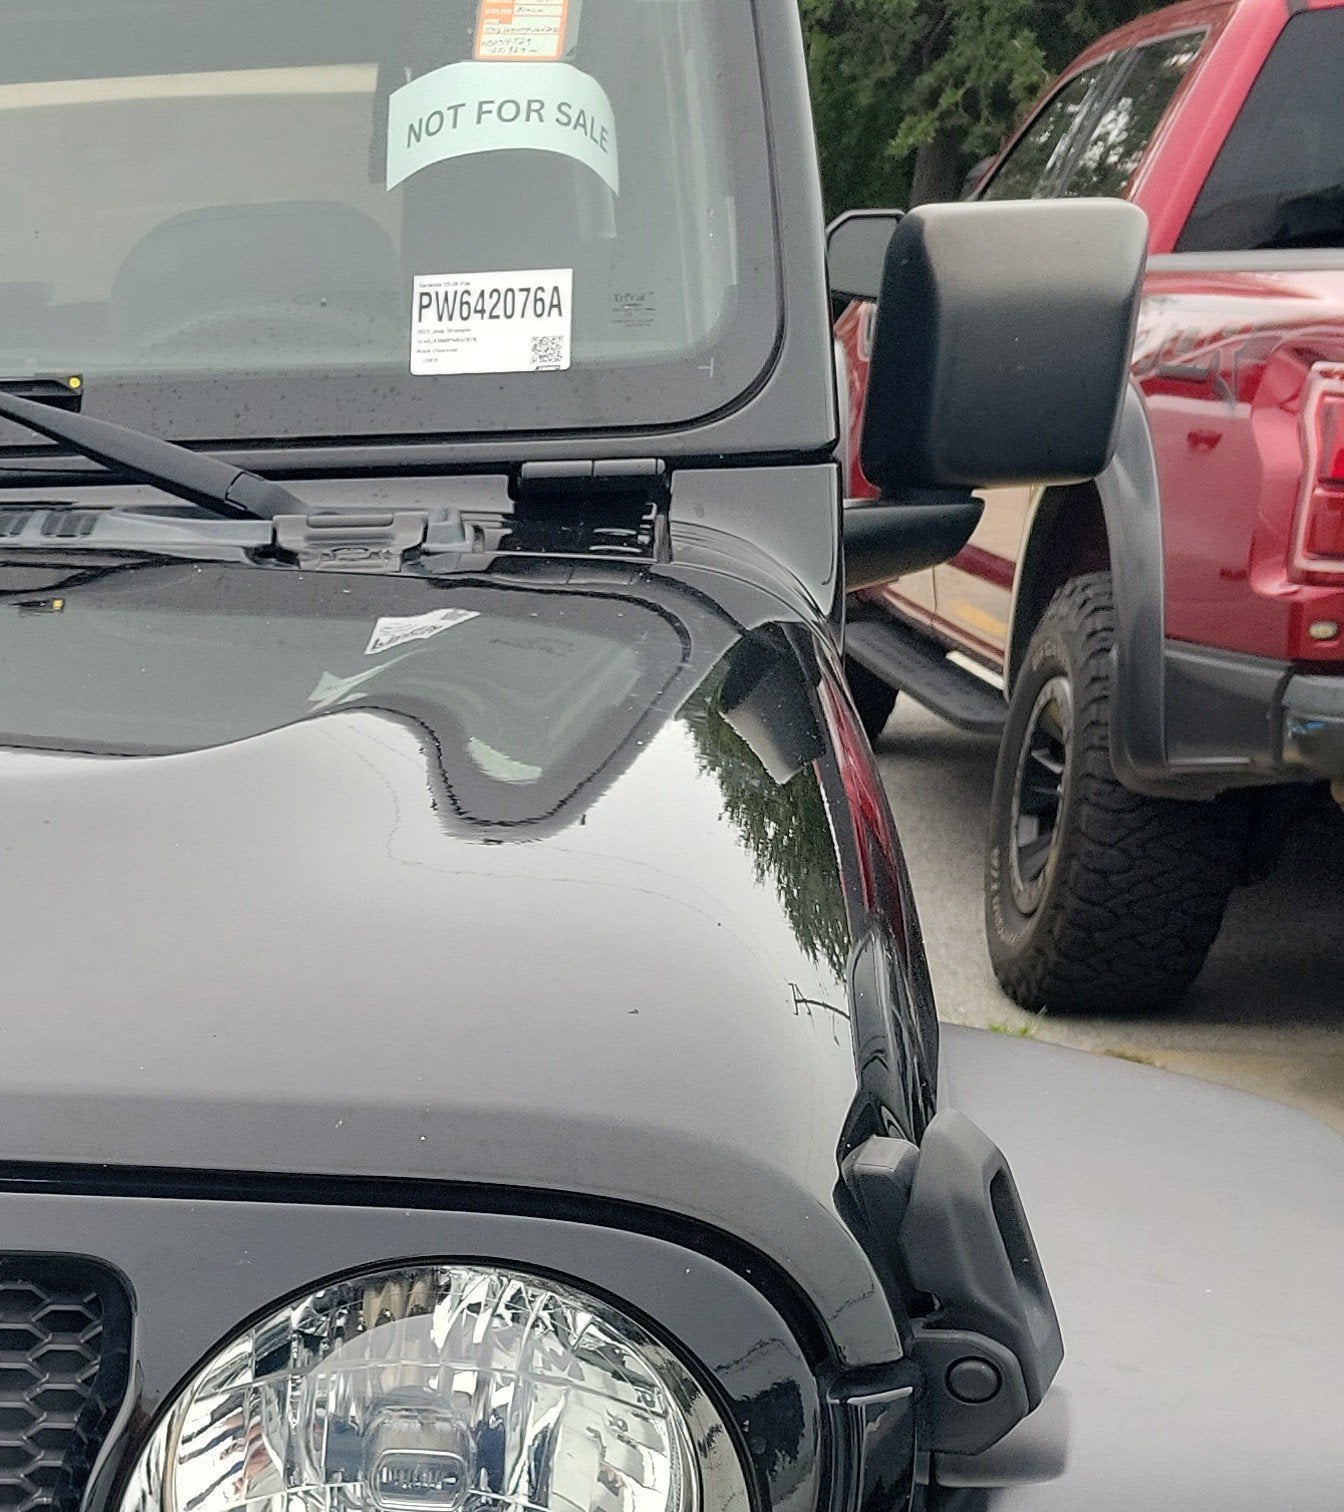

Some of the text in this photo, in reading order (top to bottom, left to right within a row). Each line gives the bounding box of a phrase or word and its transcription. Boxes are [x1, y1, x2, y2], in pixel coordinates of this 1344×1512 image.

[407, 99, 608, 153] NOT FOR SALE
[418, 286, 563, 323] PW642076A
